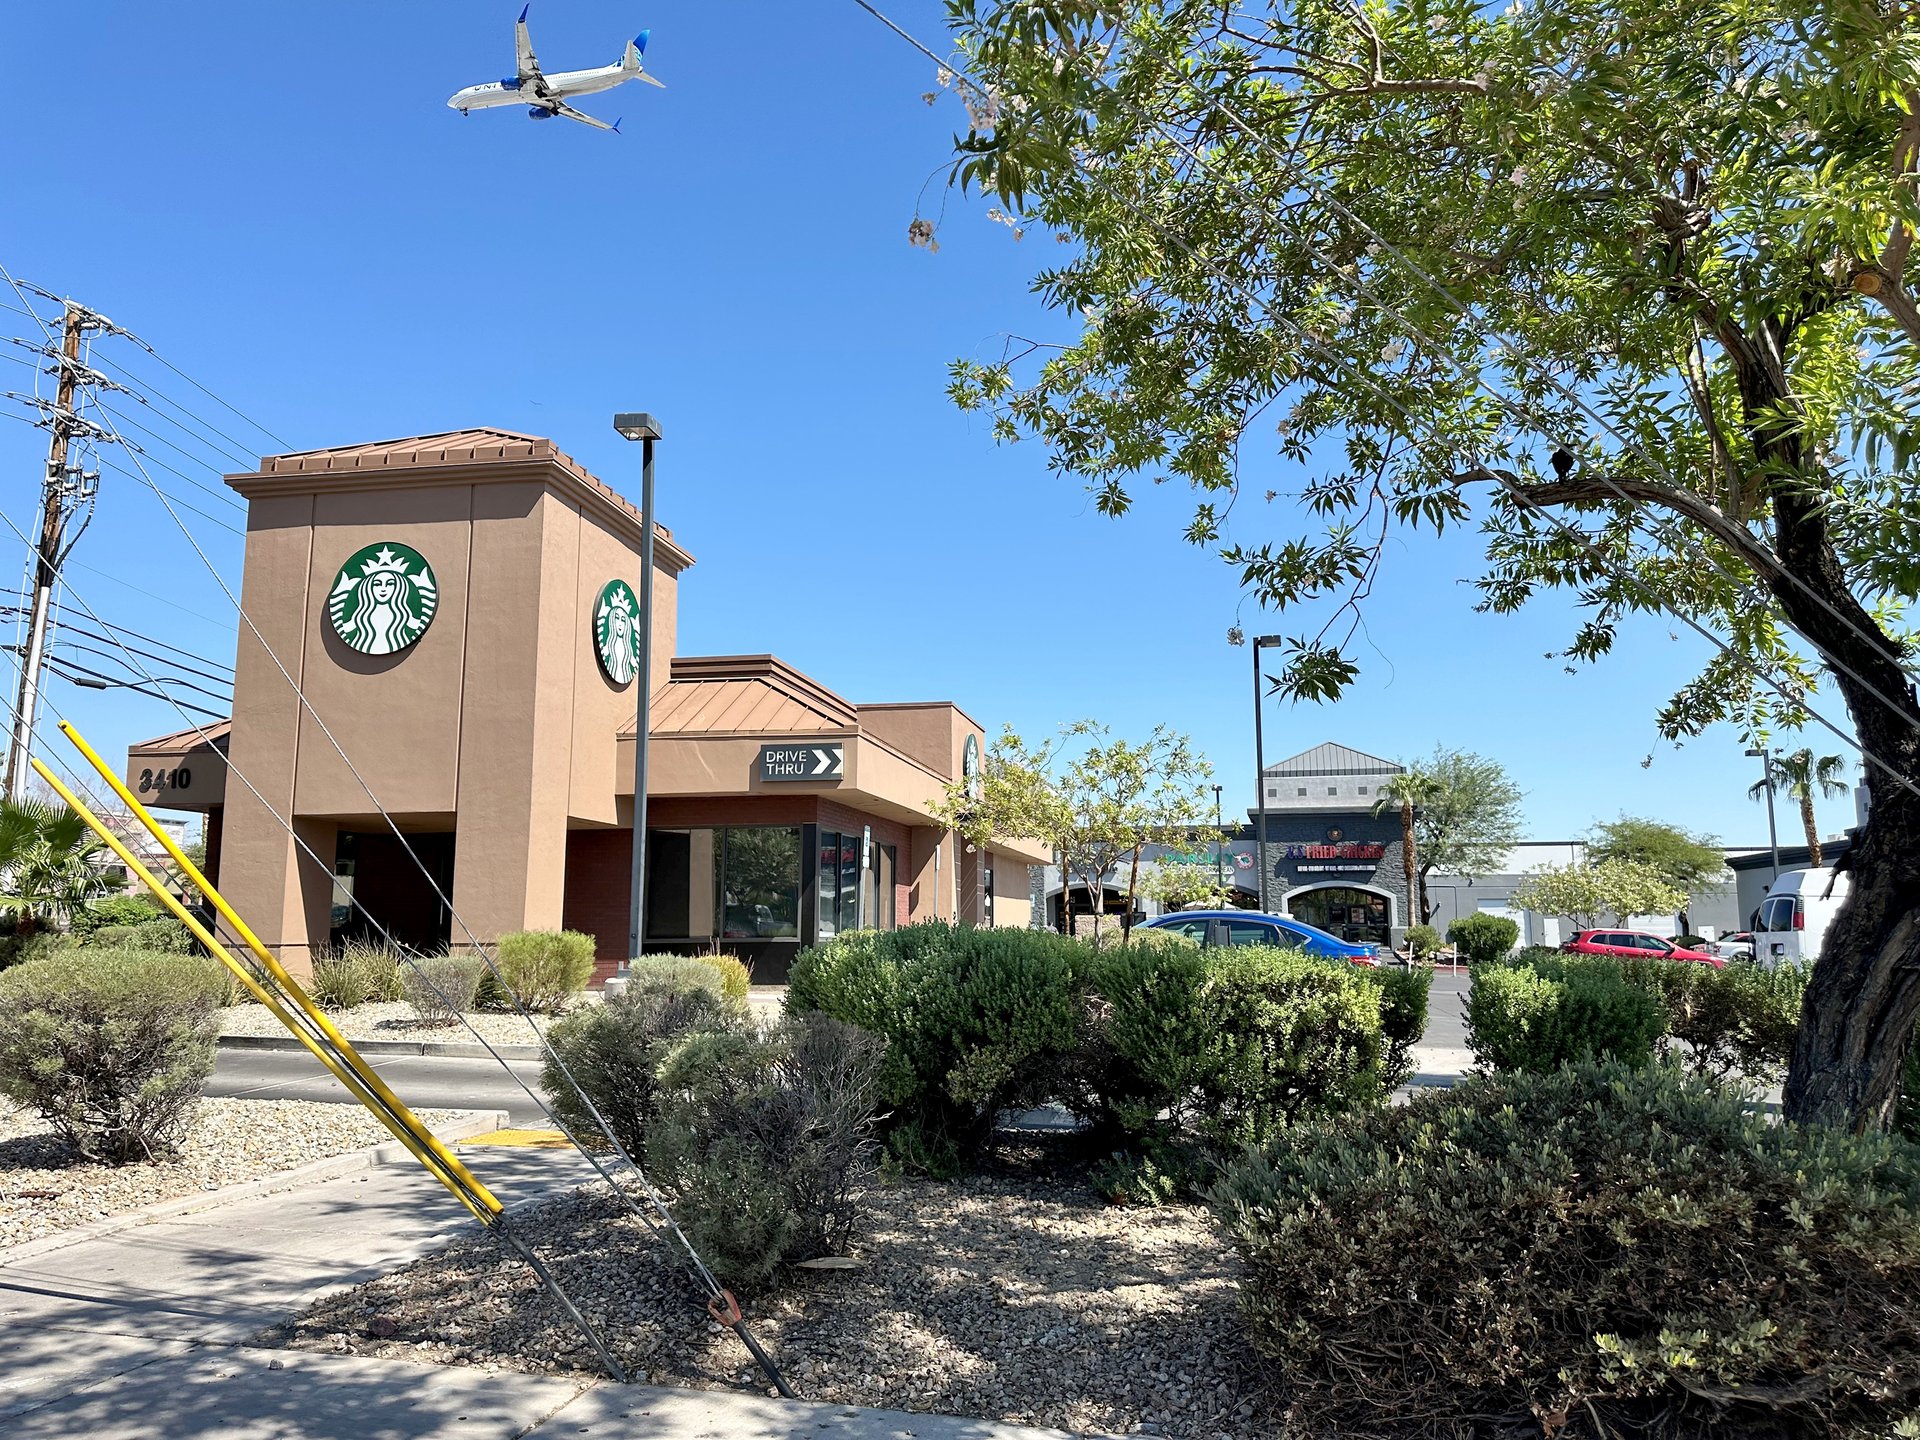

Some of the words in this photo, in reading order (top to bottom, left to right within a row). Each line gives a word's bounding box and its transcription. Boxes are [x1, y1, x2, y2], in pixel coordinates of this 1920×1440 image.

[766, 750, 807, 762] DRIVE
[766, 763, 804, 775] THRU
[139, 768, 191, 793] 3410
[1306, 845, 1337, 859] FRIED
